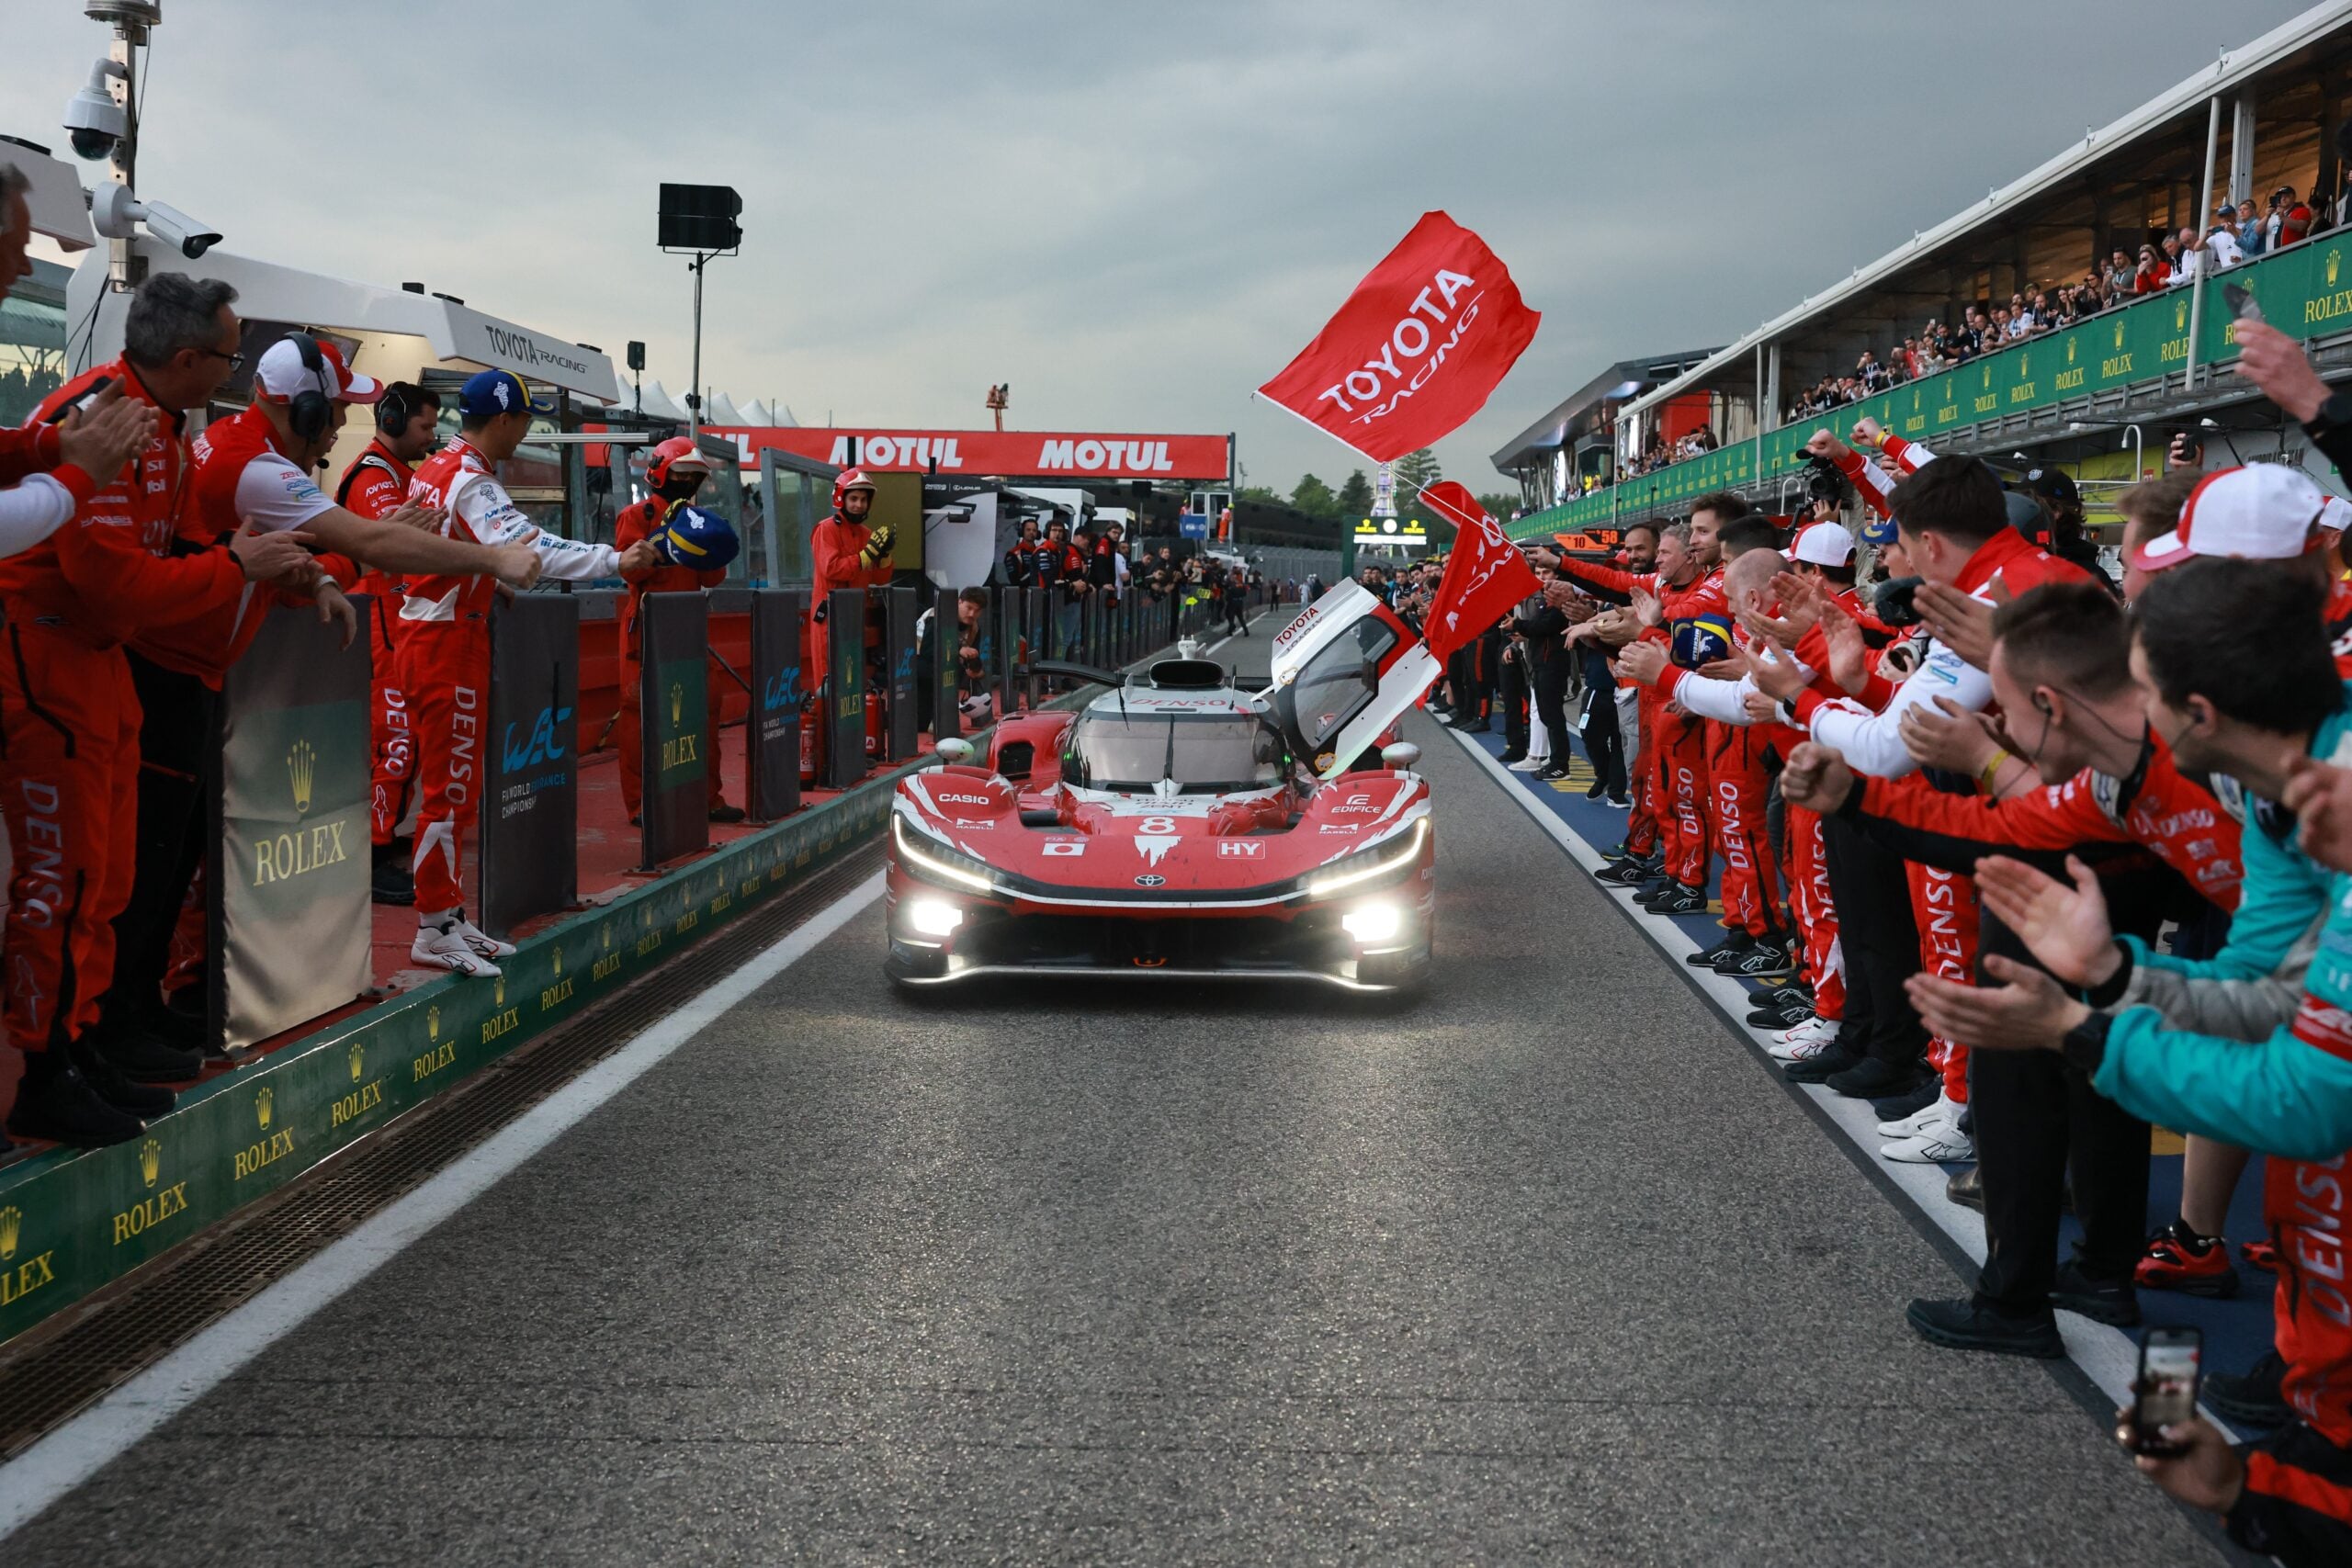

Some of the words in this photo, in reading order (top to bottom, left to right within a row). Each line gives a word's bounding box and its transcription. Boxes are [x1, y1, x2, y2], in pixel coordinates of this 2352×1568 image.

[2304, 289, 2352, 323] ROLEX
[485, 324, 539, 367] TOYOTA
[535, 348, 588, 374] RACING
[1318, 268, 1475, 412] TOYOTA
[2161, 336, 2189, 362] ROLE
[1351, 289, 1485, 424] RACING
[2102, 353, 2132, 379] ROLEX
[2011, 382, 2035, 404] ROLEX
[2055, 367, 2084, 391] ROLEX
[1939, 404, 1958, 424] ROLEX
[1974, 393, 1997, 413] ROLEX
[1906, 414, 1926, 433] ROLEX
[829, 435, 963, 468] MOTUL
[1037, 439, 1173, 471] MOTUL
[408, 477, 441, 508] OYOTA
[1574, 536, 1585, 548] 10
[1601, 530, 1618, 544] 58
[1275, 607, 1318, 645] TOYOTA
[764, 667, 800, 711] WEC
[1130, 698, 1227, 706] DENSO
[840, 693, 862, 720] ROLEX
[384, 687, 411, 776] DENSO
[446, 685, 477, 806] DENSO
[502, 705, 572, 773] WEC
[662, 734, 697, 772] ROLEX
[510, 783, 530, 797] WORLD
[938, 793, 989, 806] CASIO
[1678, 767, 1699, 835] DENSO
[1138, 816, 1176, 835] 8
[1331, 806, 1382, 814] EDIFICE
[1720, 782, 1749, 869] DENSO
[21, 778, 62, 930] DENSO
[253, 820, 346, 887] ROLEX
[1221, 842, 1261, 855] HY
[742, 876, 760, 897] ROLEX
[711, 891, 731, 916] ROLEX
[676, 910, 698, 935] ROLEX
[637, 929, 662, 958] ROLEX
[593, 951, 621, 982] ROLEX
[541, 976, 572, 1011] ROLEX
[481, 1007, 518, 1044] ROLEX
[413, 1040, 456, 1083] ROLEX
[332, 1080, 381, 1128] ROLEX
[234, 1126, 295, 1180] ROLEX
[113, 1182, 188, 1246] ROLEX
[0, 1250, 55, 1307] LEX
